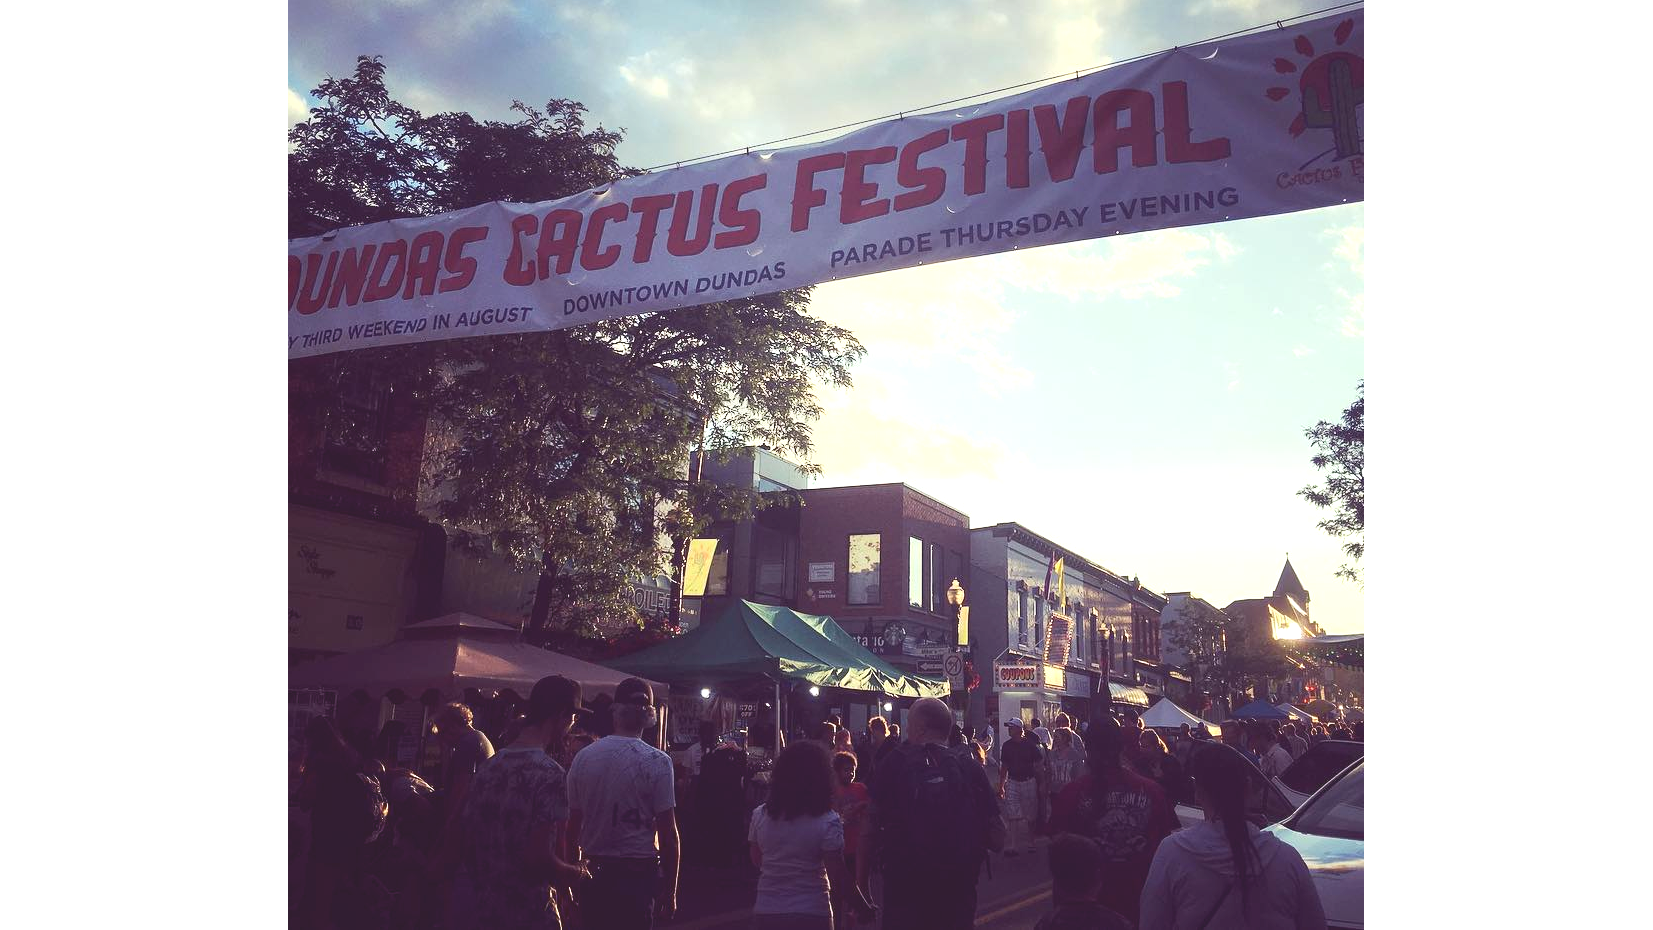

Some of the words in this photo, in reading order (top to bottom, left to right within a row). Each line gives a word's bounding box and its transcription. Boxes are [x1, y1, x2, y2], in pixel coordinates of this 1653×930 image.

[503, 173, 767, 287] CACTUS
[790, 80, 1232, 233] FESTIVAL
[831, 232, 934, 268] PARADE
[941, 206, 1090, 248] THURSDAY
[1100, 186, 1240, 224] EVENING
[563, 279, 689, 316] DOWNTOWN
[695, 261, 787, 294] DUNDAS
[302, 328, 343, 349] THIRD
[348, 317, 427, 341] WEEKEND
[432, 313, 451, 331] IN
[455, 307, 534, 328] AUGUST
[1000, 667, 1035, 681] COUPONS
